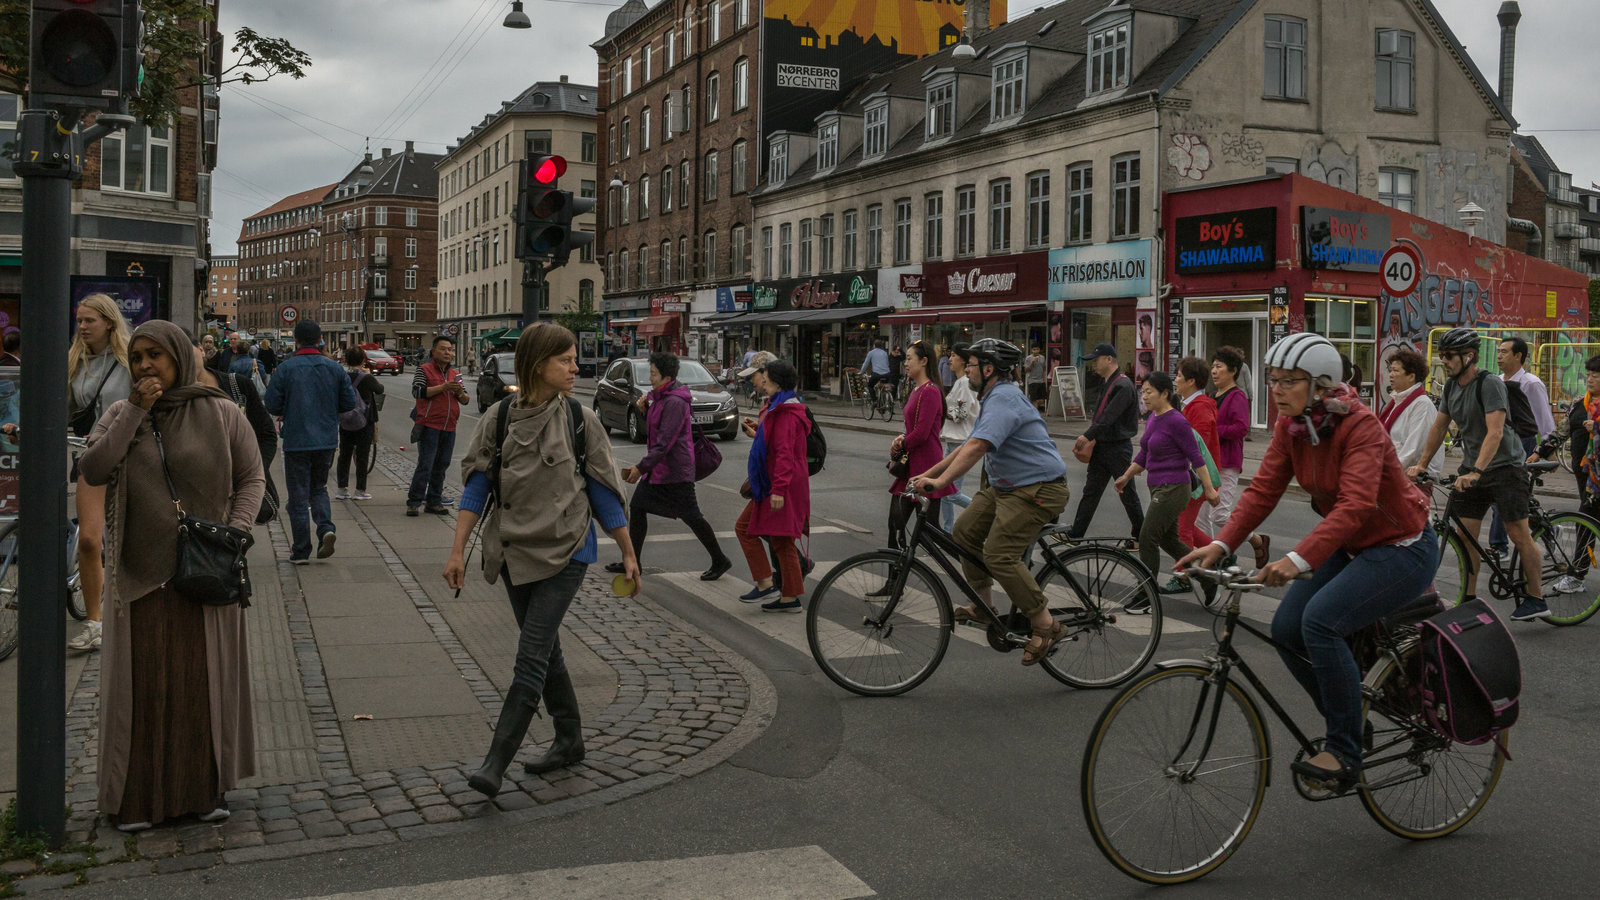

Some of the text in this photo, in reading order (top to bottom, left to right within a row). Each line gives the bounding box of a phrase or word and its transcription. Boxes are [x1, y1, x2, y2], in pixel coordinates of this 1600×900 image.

[779, 65, 839, 78] NØRREBRO
[779, 75, 838, 89] BYCENTER
[30, 151, 39, 161] 7
[1179, 245, 1264, 268] SHAWARMA
[1311, 244, 1383, 266] SHAWARMA
[967, 267, 1016, 293] Caesar
[1062, 260, 1146, 283] FRISØRSALON
[1386, 262, 1413, 281] 40
